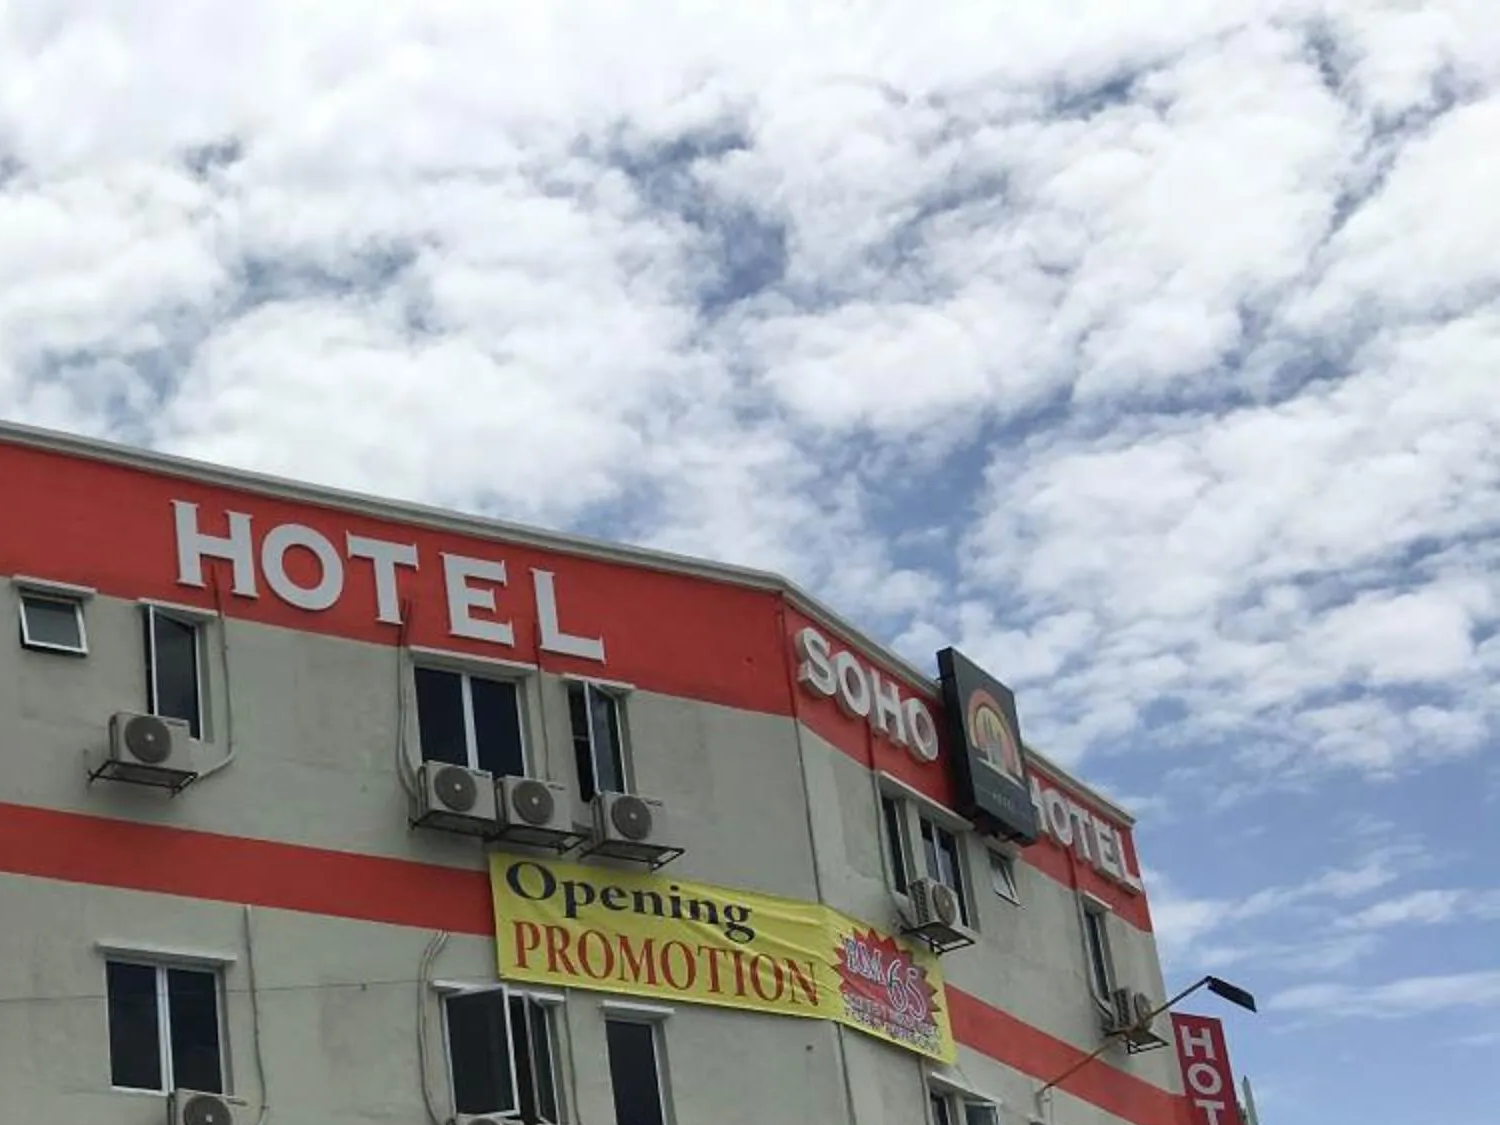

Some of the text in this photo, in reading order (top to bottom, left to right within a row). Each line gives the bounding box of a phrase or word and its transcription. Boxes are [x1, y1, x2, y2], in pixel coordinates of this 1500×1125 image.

[172, 498, 606, 664] HOTEL
[795, 626, 939, 763] SOHO
[505, 860, 756, 945] Opening
[511, 919, 820, 1008] PROMOTION
